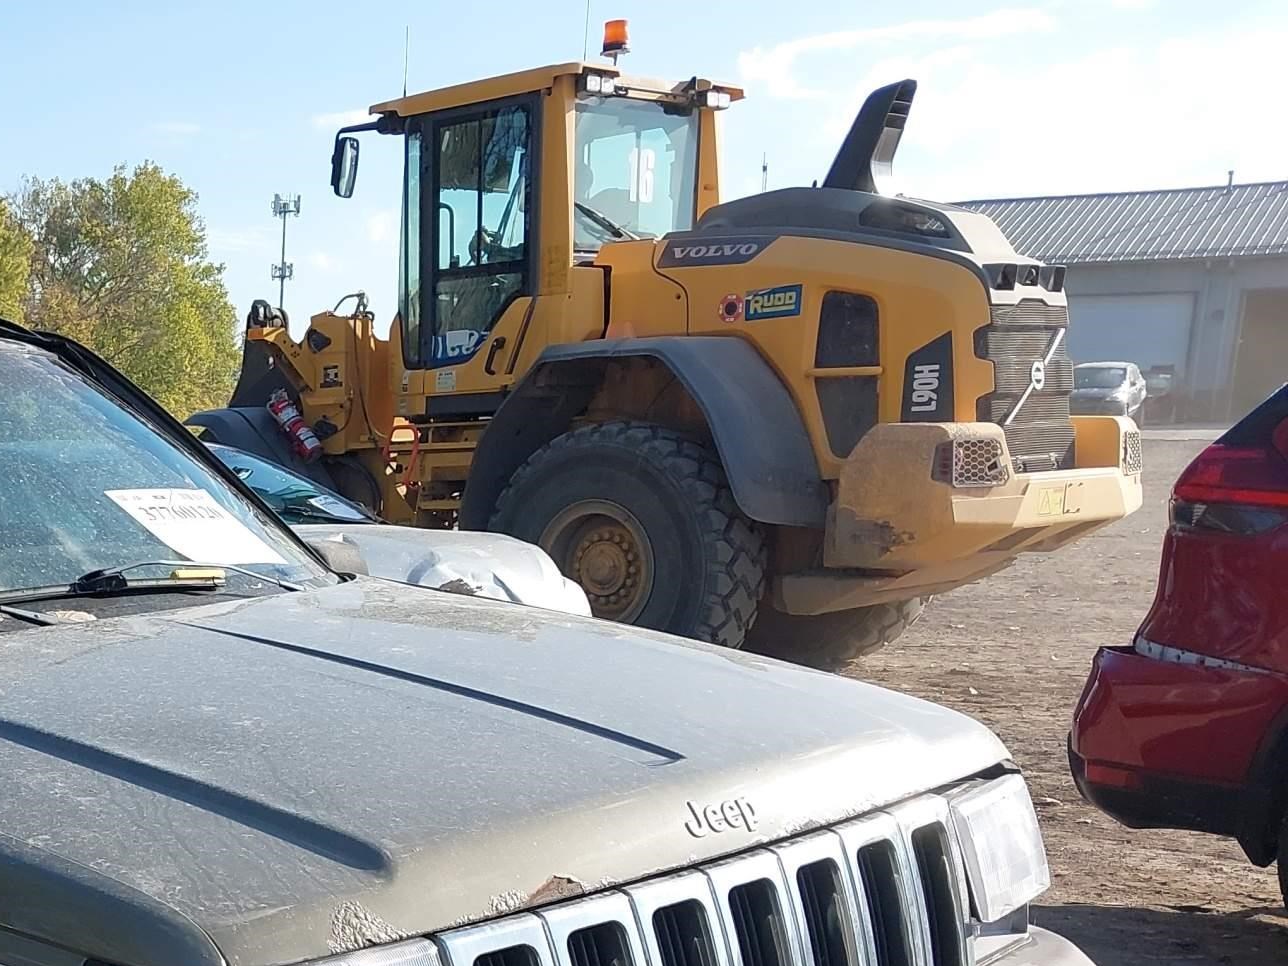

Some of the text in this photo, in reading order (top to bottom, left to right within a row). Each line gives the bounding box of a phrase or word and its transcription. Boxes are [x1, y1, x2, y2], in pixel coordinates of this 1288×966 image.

[673, 243, 758, 258] VOLVO
[749, 292, 797, 314] RUDD
[911, 364, 940, 412] L90H
[684, 798, 756, 838] Jeep
